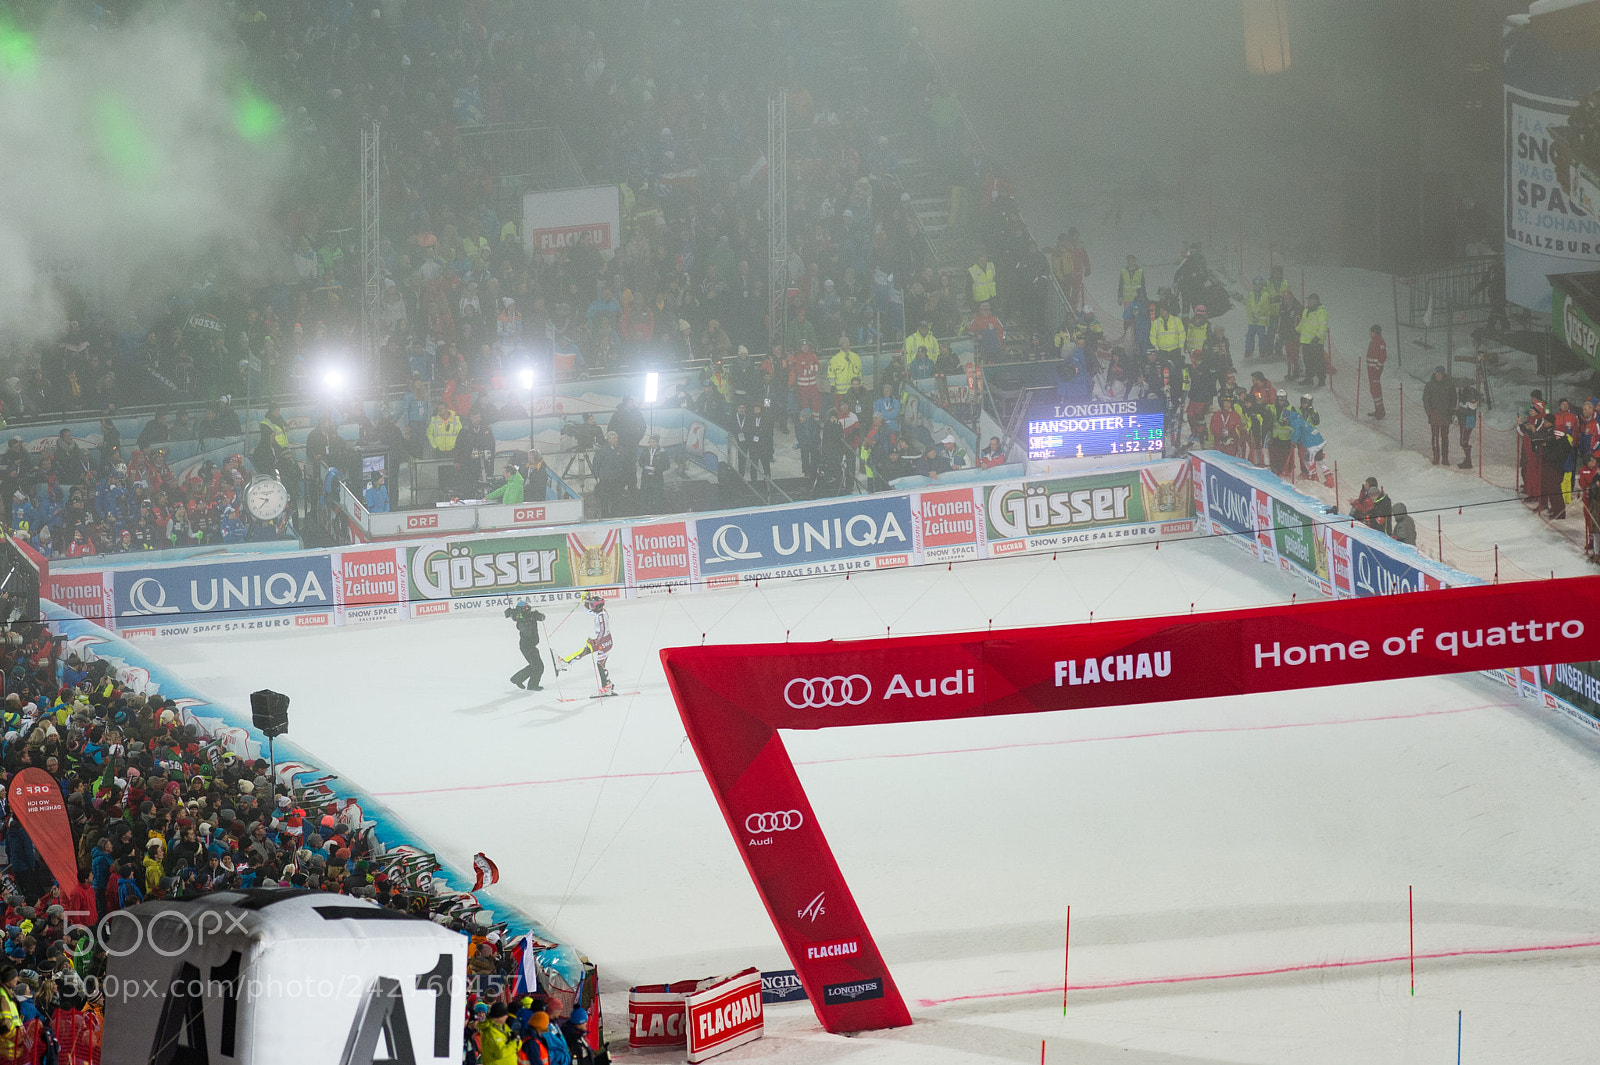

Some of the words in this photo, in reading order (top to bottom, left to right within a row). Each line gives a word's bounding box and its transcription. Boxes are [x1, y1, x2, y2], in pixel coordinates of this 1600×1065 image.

[1518, 132, 1557, 164] SN
[1519, 162, 1553, 182] WAG
[1054, 401, 1137, 418] LONGINES
[1029, 417, 1124, 434] HANSDOTTER
[1128, 415, 1141, 428] F.
[1125, 428, 1163, 440] -1.19
[1076, 444, 1084, 458] 1
[1110, 439, 1163, 454] 1:52.29
[516, 509, 543, 520] ORF
[922, 500, 972, 518] Kronen
[988, 483, 1131, 538] Gösser
[409, 516, 436, 527] ORF
[924, 518, 974, 536] Zeitung
[1163, 523, 1190, 532] FLACHAU
[634, 534, 685, 551] Kronen
[772, 512, 906, 556] UNIQA
[1030, 538, 1058, 547] SNOW
[1062, 534, 1089, 544] SPACE
[1092, 527, 1156, 540] SALZBURG
[926, 549, 949, 558] SNOW
[951, 546, 975, 555] SPACE
[996, 541, 1025, 553] FLACHAU
[637, 552, 687, 569] Zeitung
[879, 557, 906, 566] FLACHAU
[344, 561, 395, 578] Kronen
[411, 543, 558, 600] Gösser
[744, 573, 772, 582] SNOW
[775, 568, 803, 579] SPACE
[807, 560, 871, 575] SALZBURG
[345, 579, 396, 597] Zeitung
[1377, 566, 1418, 596] UNI
[51, 584, 101, 599] Kronen
[190, 570, 327, 611] UNIQA
[61, 602, 102, 617] itung
[419, 603, 446, 614] FLACHAU
[454, 601, 482, 610] SNOW
[486, 597, 513, 607] SPACE
[298, 616, 326, 624] FLACHAU
[347, 610, 372, 618] SNOW
[373, 607, 398, 616] SPACE
[161, 627, 189, 636] SNOW
[1254, 640, 1370, 669] Home
[1382, 627, 1424, 656] of
[1435, 619, 1585, 657] quattro
[1054, 651, 1172, 687] FLACHAU
[882, 668, 976, 700] Audi
[1555, 663, 1583, 695] UNSER
[749, 837, 773, 846] Audi
[807, 941, 858, 959] FLACHAU
[761, 974, 802, 990] NGIN
[828, 982, 878, 996] LONGINES
[338, 954, 454, 1065] A1
[700, 992, 761, 1040] FLACHAU
[629, 1013, 686, 1038] FLAC
